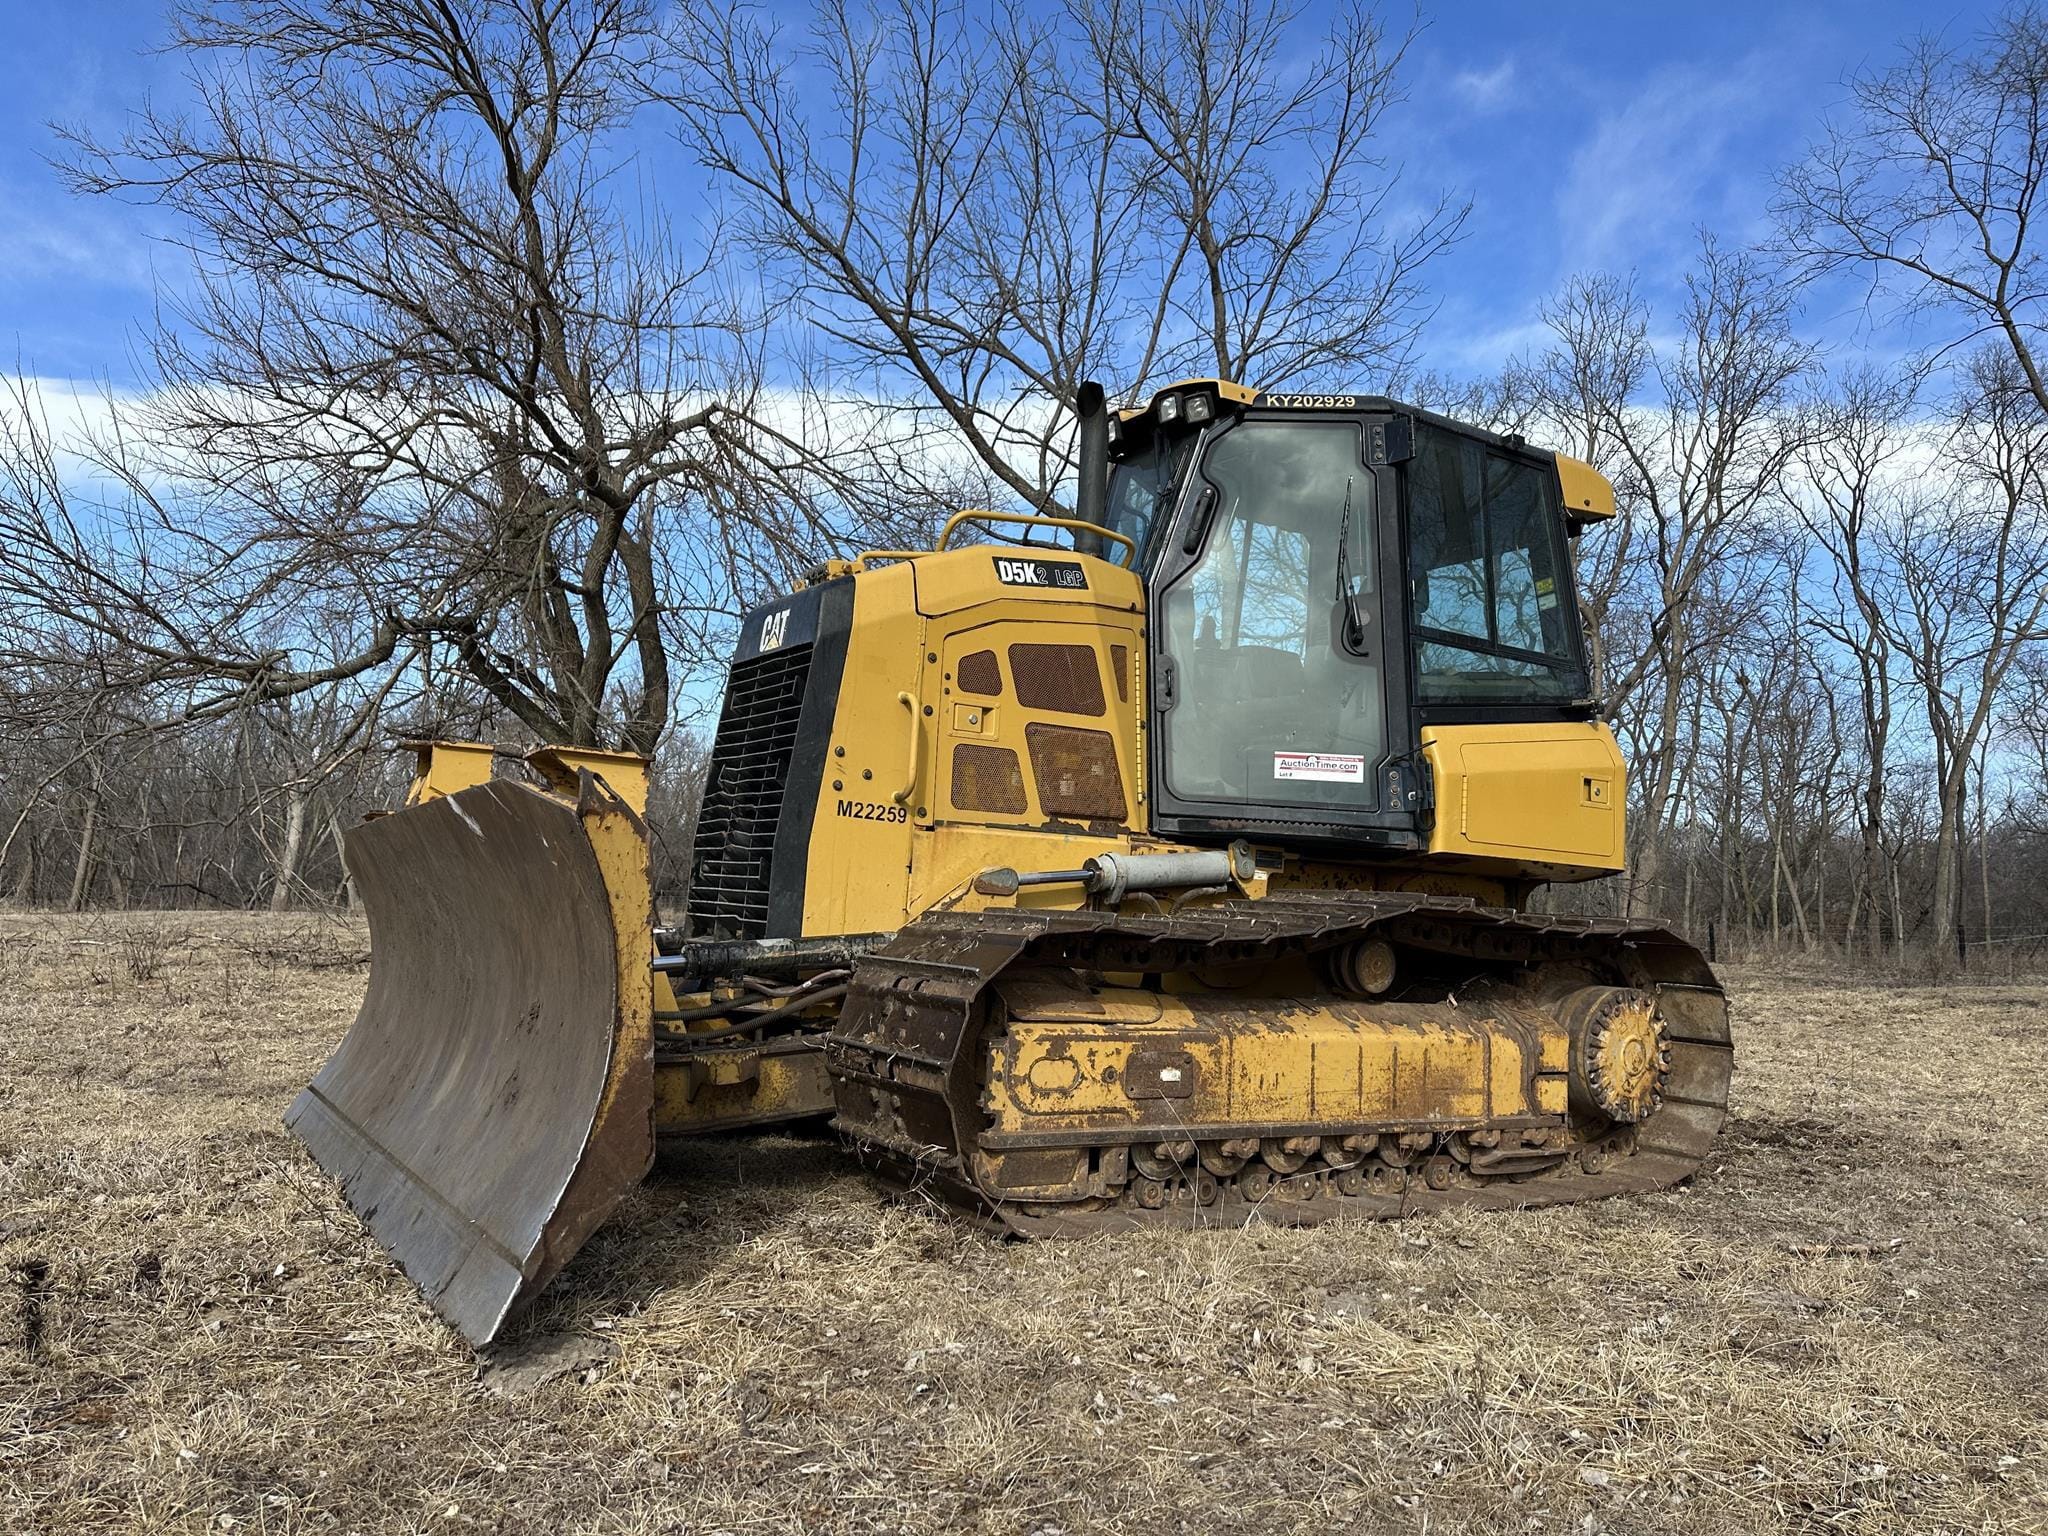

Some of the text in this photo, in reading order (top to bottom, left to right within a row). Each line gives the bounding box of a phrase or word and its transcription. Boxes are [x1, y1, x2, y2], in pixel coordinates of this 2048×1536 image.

[1266, 395, 1355, 407] KY202929
[1055, 569, 1083, 587] LGP
[760, 608, 790, 652] CAT
[1280, 759, 1358, 771] AuctionTime.com
[837, 800, 907, 823] M22259
